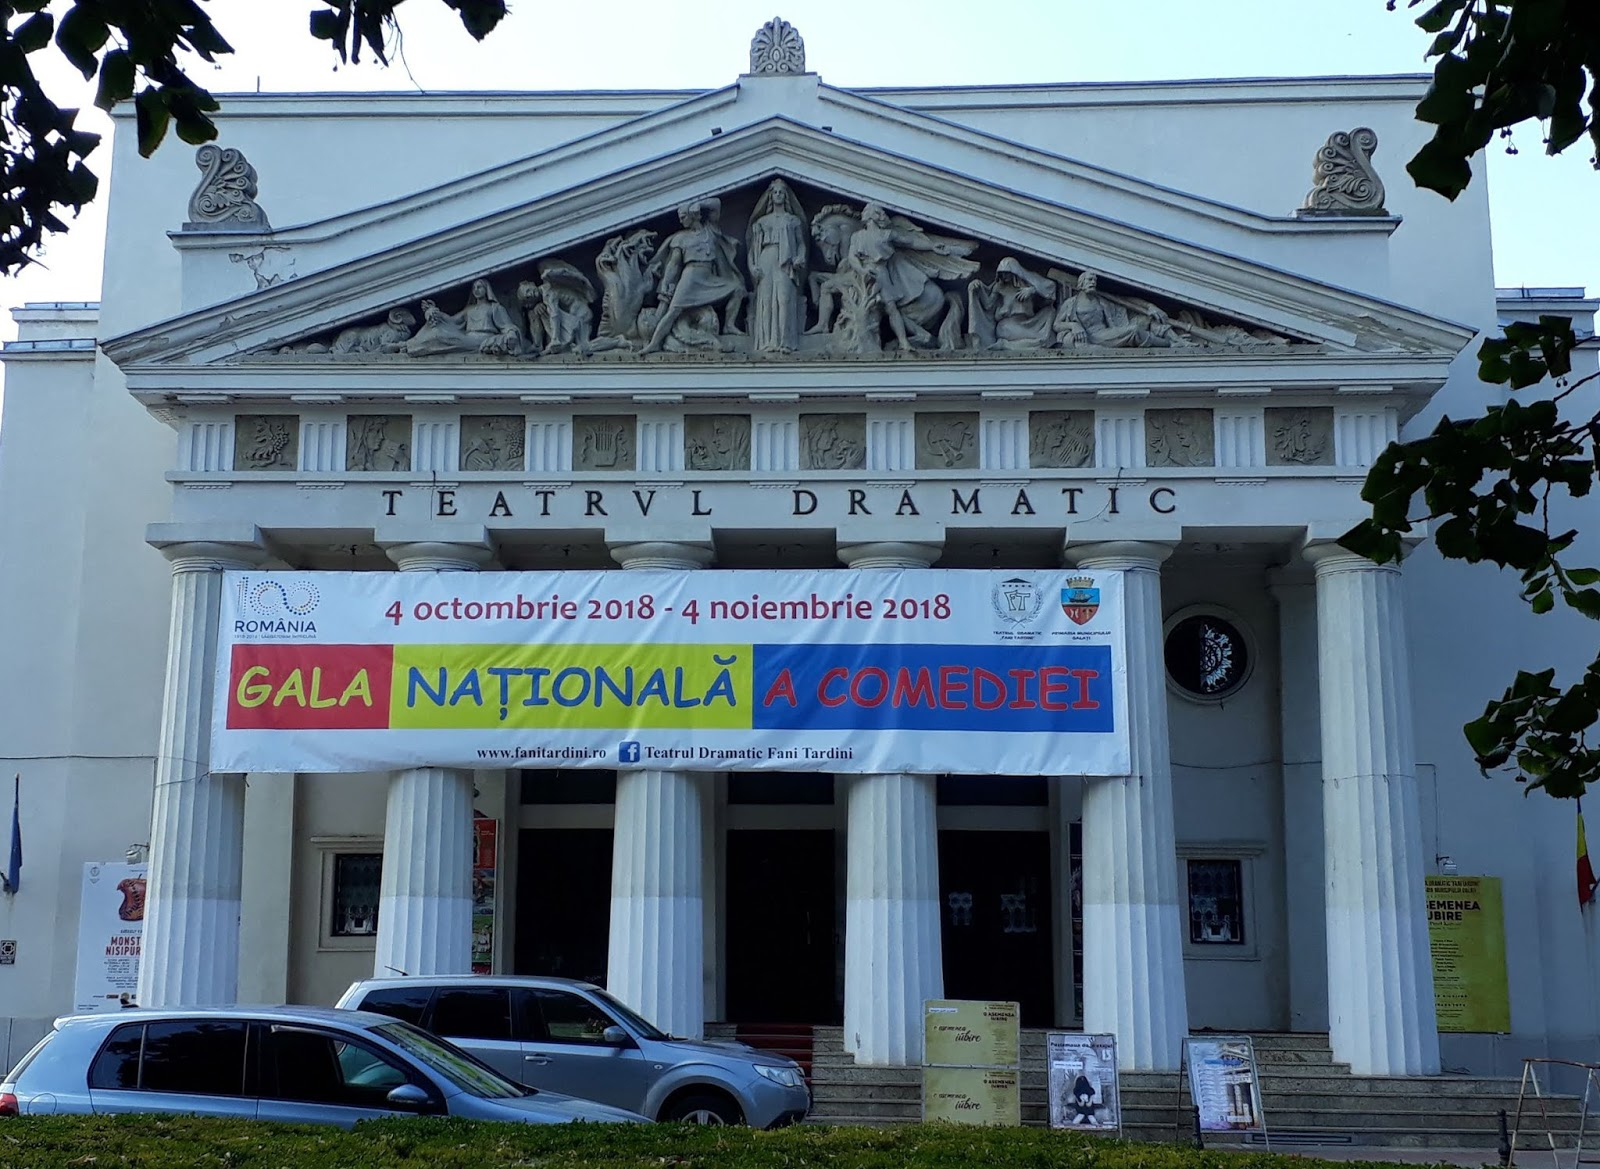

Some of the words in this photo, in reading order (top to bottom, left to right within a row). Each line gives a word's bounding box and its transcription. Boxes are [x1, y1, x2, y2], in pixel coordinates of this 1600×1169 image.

[382, 489, 712, 517] TEATRVL
[792, 487, 1176, 515] DRAMATIC
[385, 600, 403, 626] 4
[413, 594, 577, 620] octombrie
[587, 594, 655, 620] 2018
[682, 599, 700, 625] 4
[710, 594, 872, 620] noiembrie
[883, 594, 951, 620] 2018
[234, 618, 317, 633] ROMÂNIA
[236, 666, 373, 708] GALA
[406, 654, 737, 721] NAȚIONALĂ
[763, 668, 797, 707] A
[817, 666, 1100, 710] COMEDIEI
[477, 746, 607, 759] www.fanitardini.ro
[644, 746, 694, 760] Teatrul
[699, 747, 763, 760] Dramatic
[767, 748, 798, 760] Fani
[801, 748, 853, 760] Tardini
